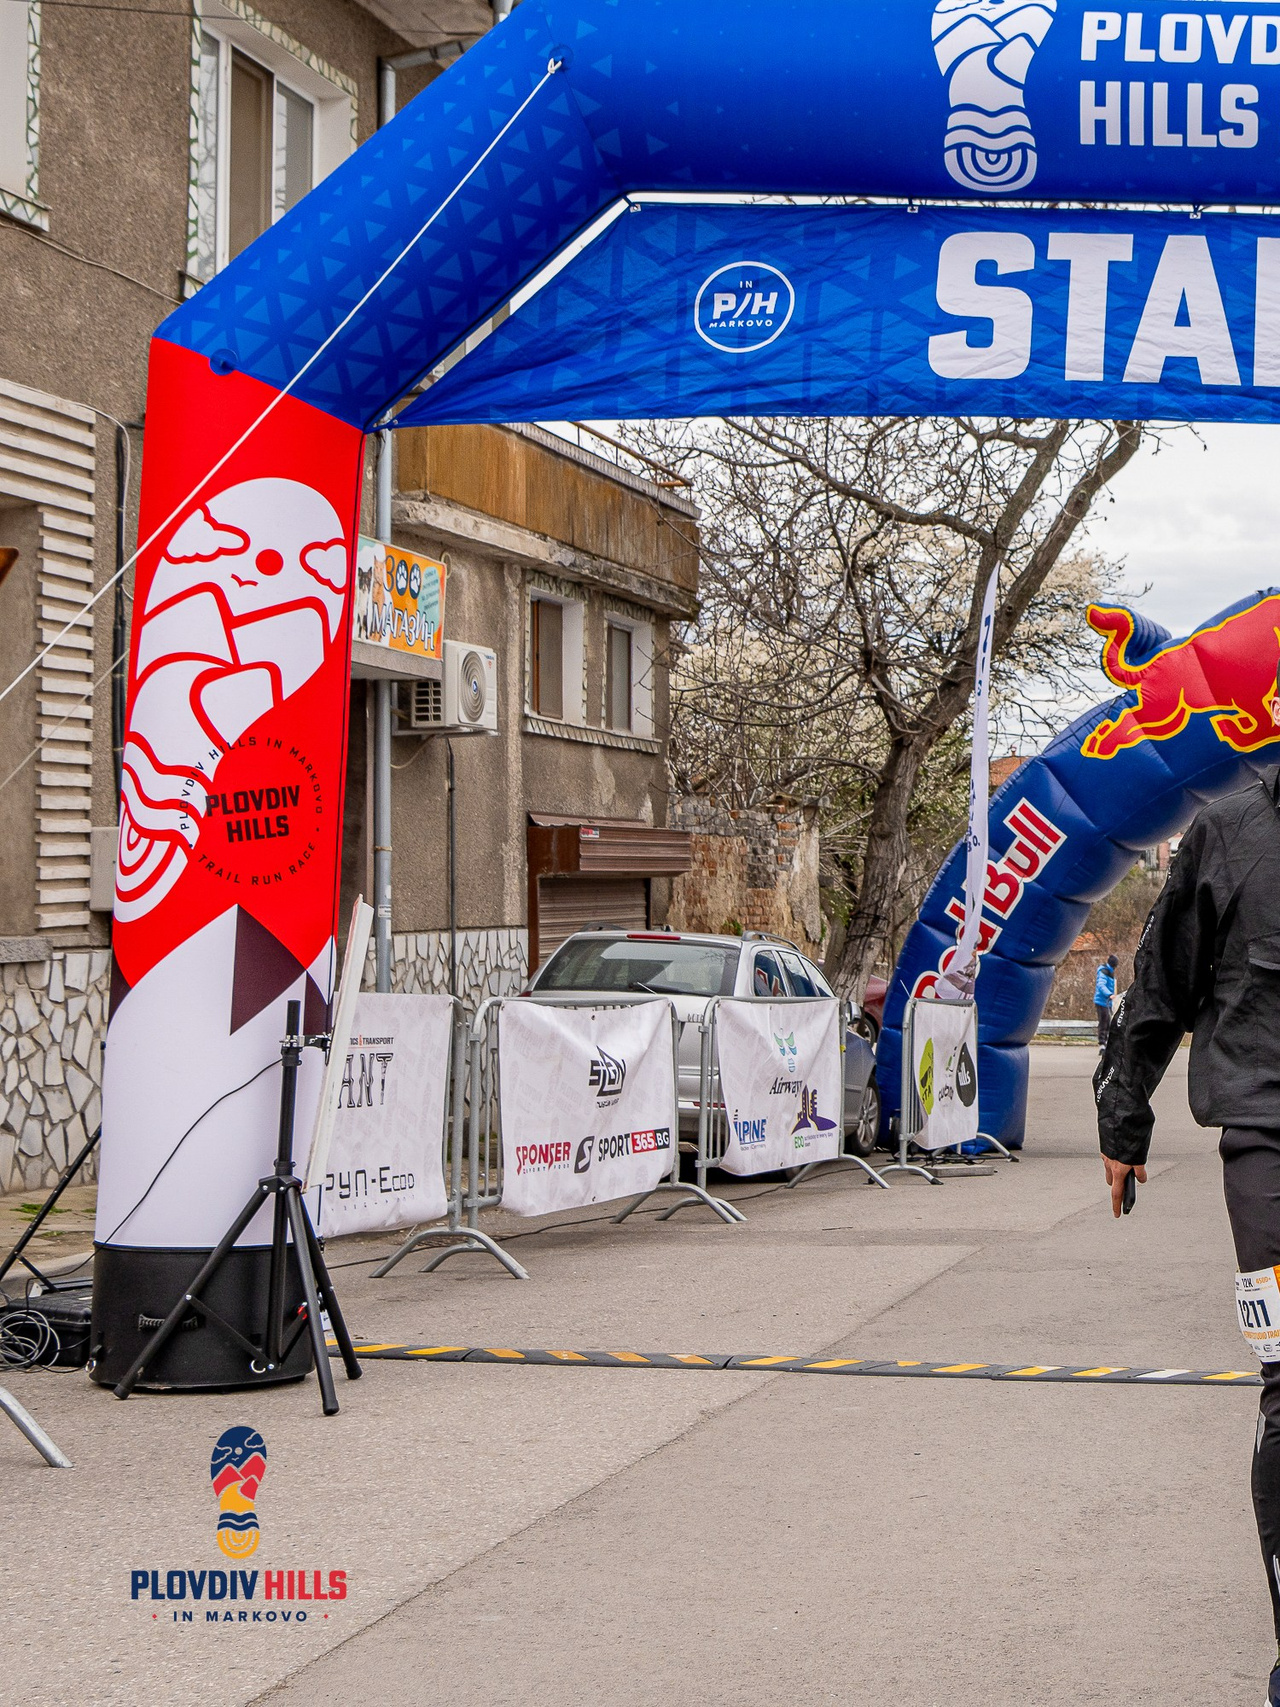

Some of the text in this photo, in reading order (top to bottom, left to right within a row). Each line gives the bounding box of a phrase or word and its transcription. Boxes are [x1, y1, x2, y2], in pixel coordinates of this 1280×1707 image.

[1080, 80, 1259, 148] HILLS
[739, 280, 753, 288] IN
[712, 292, 778, 320] P/H
[709, 319, 773, 329] MARKOVO
[370, 602, 435, 651] МАГАЗИН
[179, 737, 322, 830] PLOVDIV HILLS IN MARKOVO
[205, 785, 300, 817] PLOVDIV
[226, 815, 290, 843] HILLS
[198, 842, 315, 885] TRAIL RUN RACE
[984, 803, 1061, 914] Bull
[362, 1036, 394, 1045] TRANSPORT
[516, 1141, 571, 1175] SPONSER
[1241, 1278, 1253, 1288] 12K
